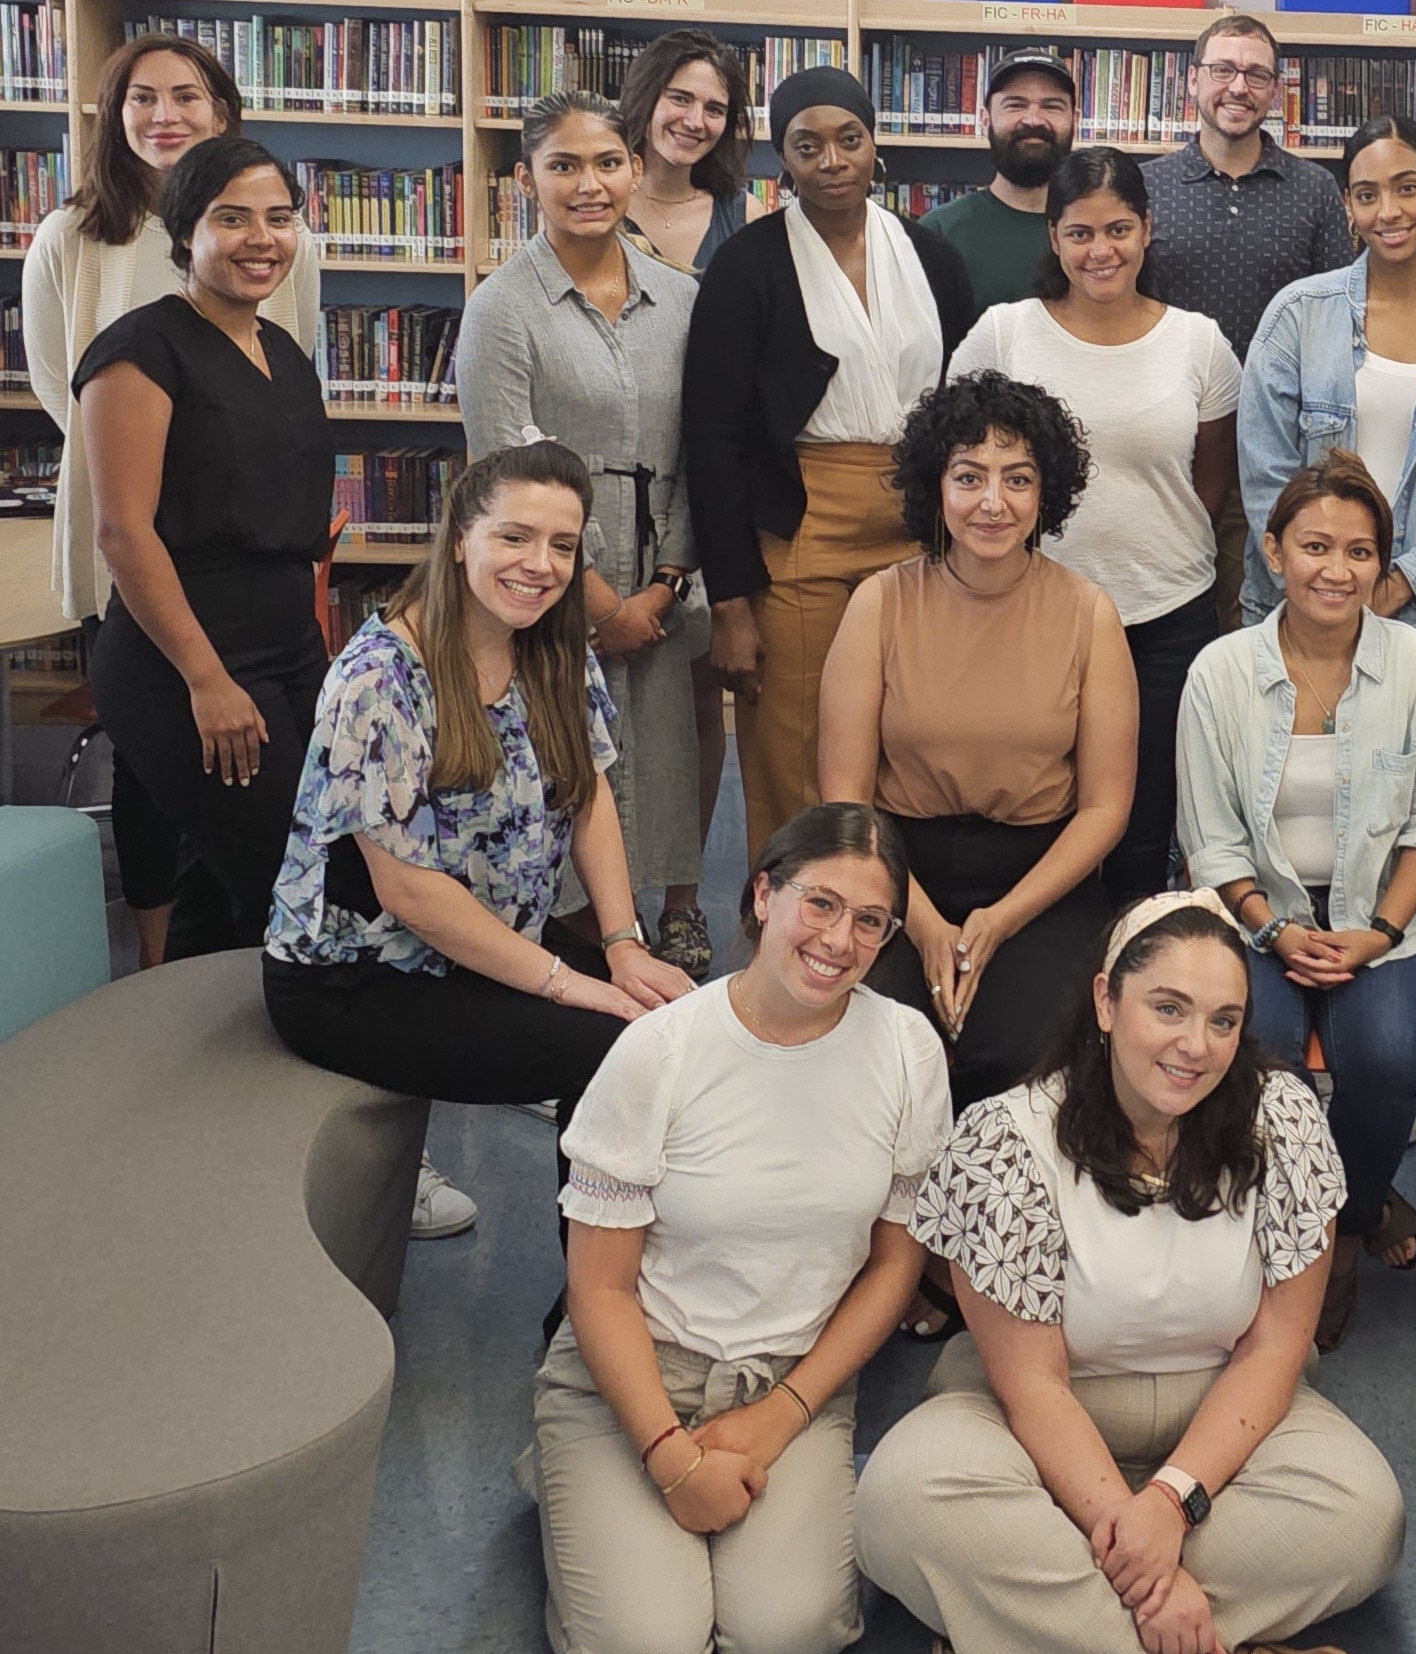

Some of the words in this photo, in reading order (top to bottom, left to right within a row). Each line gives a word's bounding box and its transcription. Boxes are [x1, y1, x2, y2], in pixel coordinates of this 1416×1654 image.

[984, 6, 1008, 20] FIC
[1021, 7, 1068, 21] FR-HA
[1365, 18, 1389, 32] FIC
